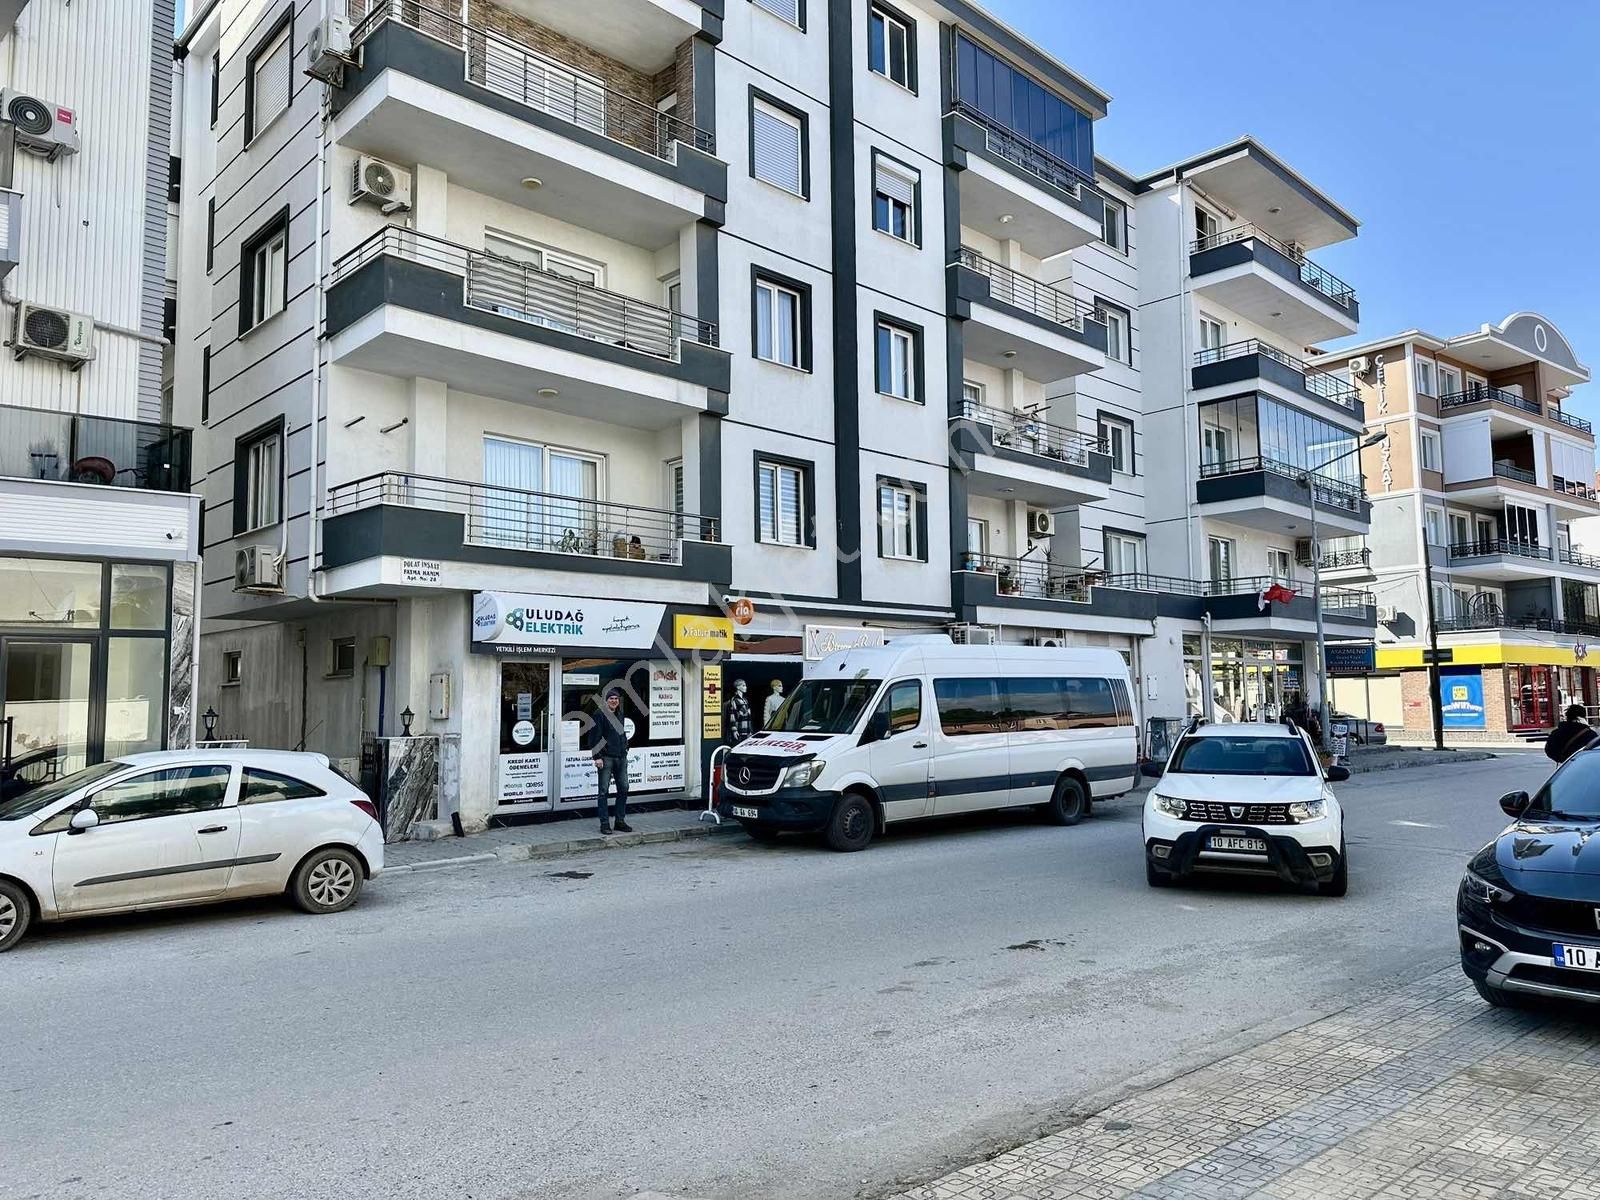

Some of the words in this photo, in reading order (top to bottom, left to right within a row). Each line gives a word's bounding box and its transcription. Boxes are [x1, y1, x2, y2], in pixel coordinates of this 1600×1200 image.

[526, 608, 584, 622] ULUDAĞ
[735, 603, 749, 616] ria
[525, 621, 583, 635] ELEKTRİK
[1212, 837, 1223, 847] 10
[1227, 838, 1244, 849] AFC
[1247, 839, 1265, 849] 813
[1566, 948, 1586, 966] 10
